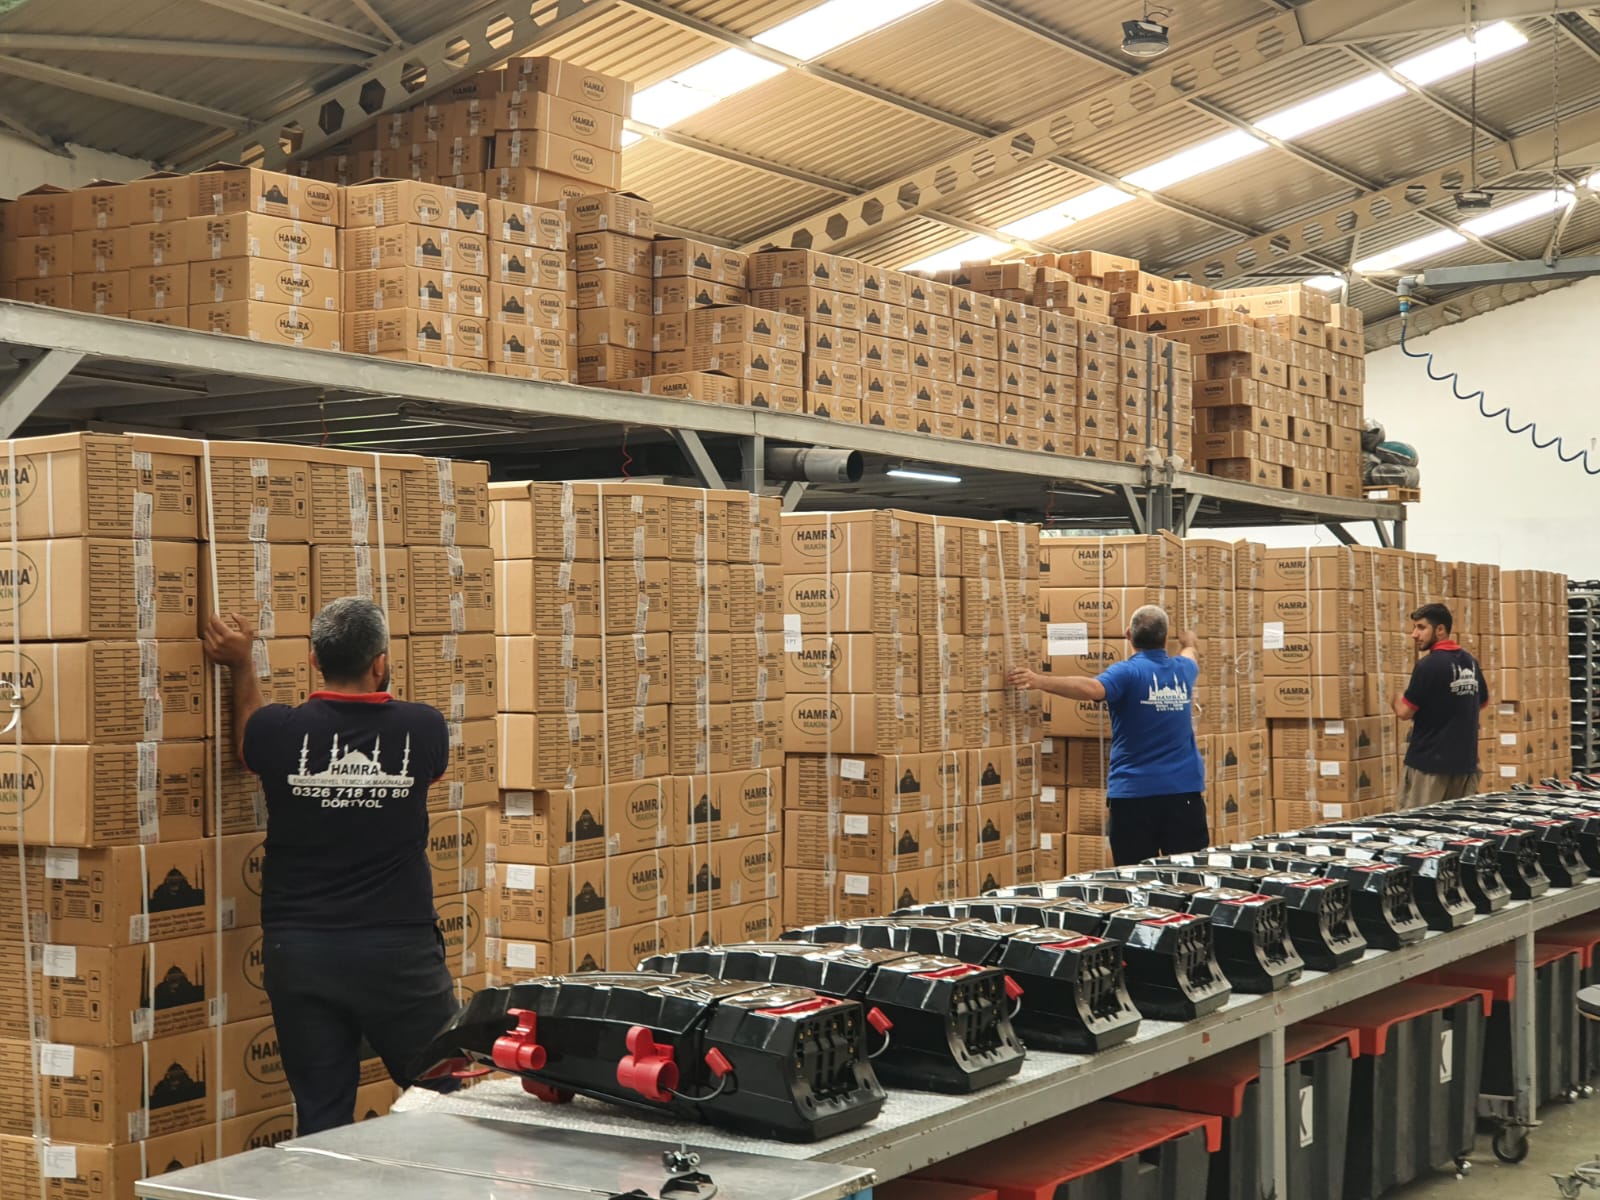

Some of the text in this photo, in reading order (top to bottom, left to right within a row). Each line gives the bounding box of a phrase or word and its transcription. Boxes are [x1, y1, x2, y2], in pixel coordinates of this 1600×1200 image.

[280, 319, 310, 331] HARA
[797, 529, 836, 541] HAMRA
[795, 589, 834, 601] HAMRA
[797, 649, 837, 661] HAMRA
[798, 709, 838, 720] HAMRA
[330, 763, 380, 776] HAMRA
[291, 786, 410, 799] 0326 718 10 80
[320, 797, 384, 809] DÖRTYOL
[430, 833, 473, 852] HAMRA
[437, 914, 473, 934] AMRA
[250, 1128, 294, 1149] HAMR
